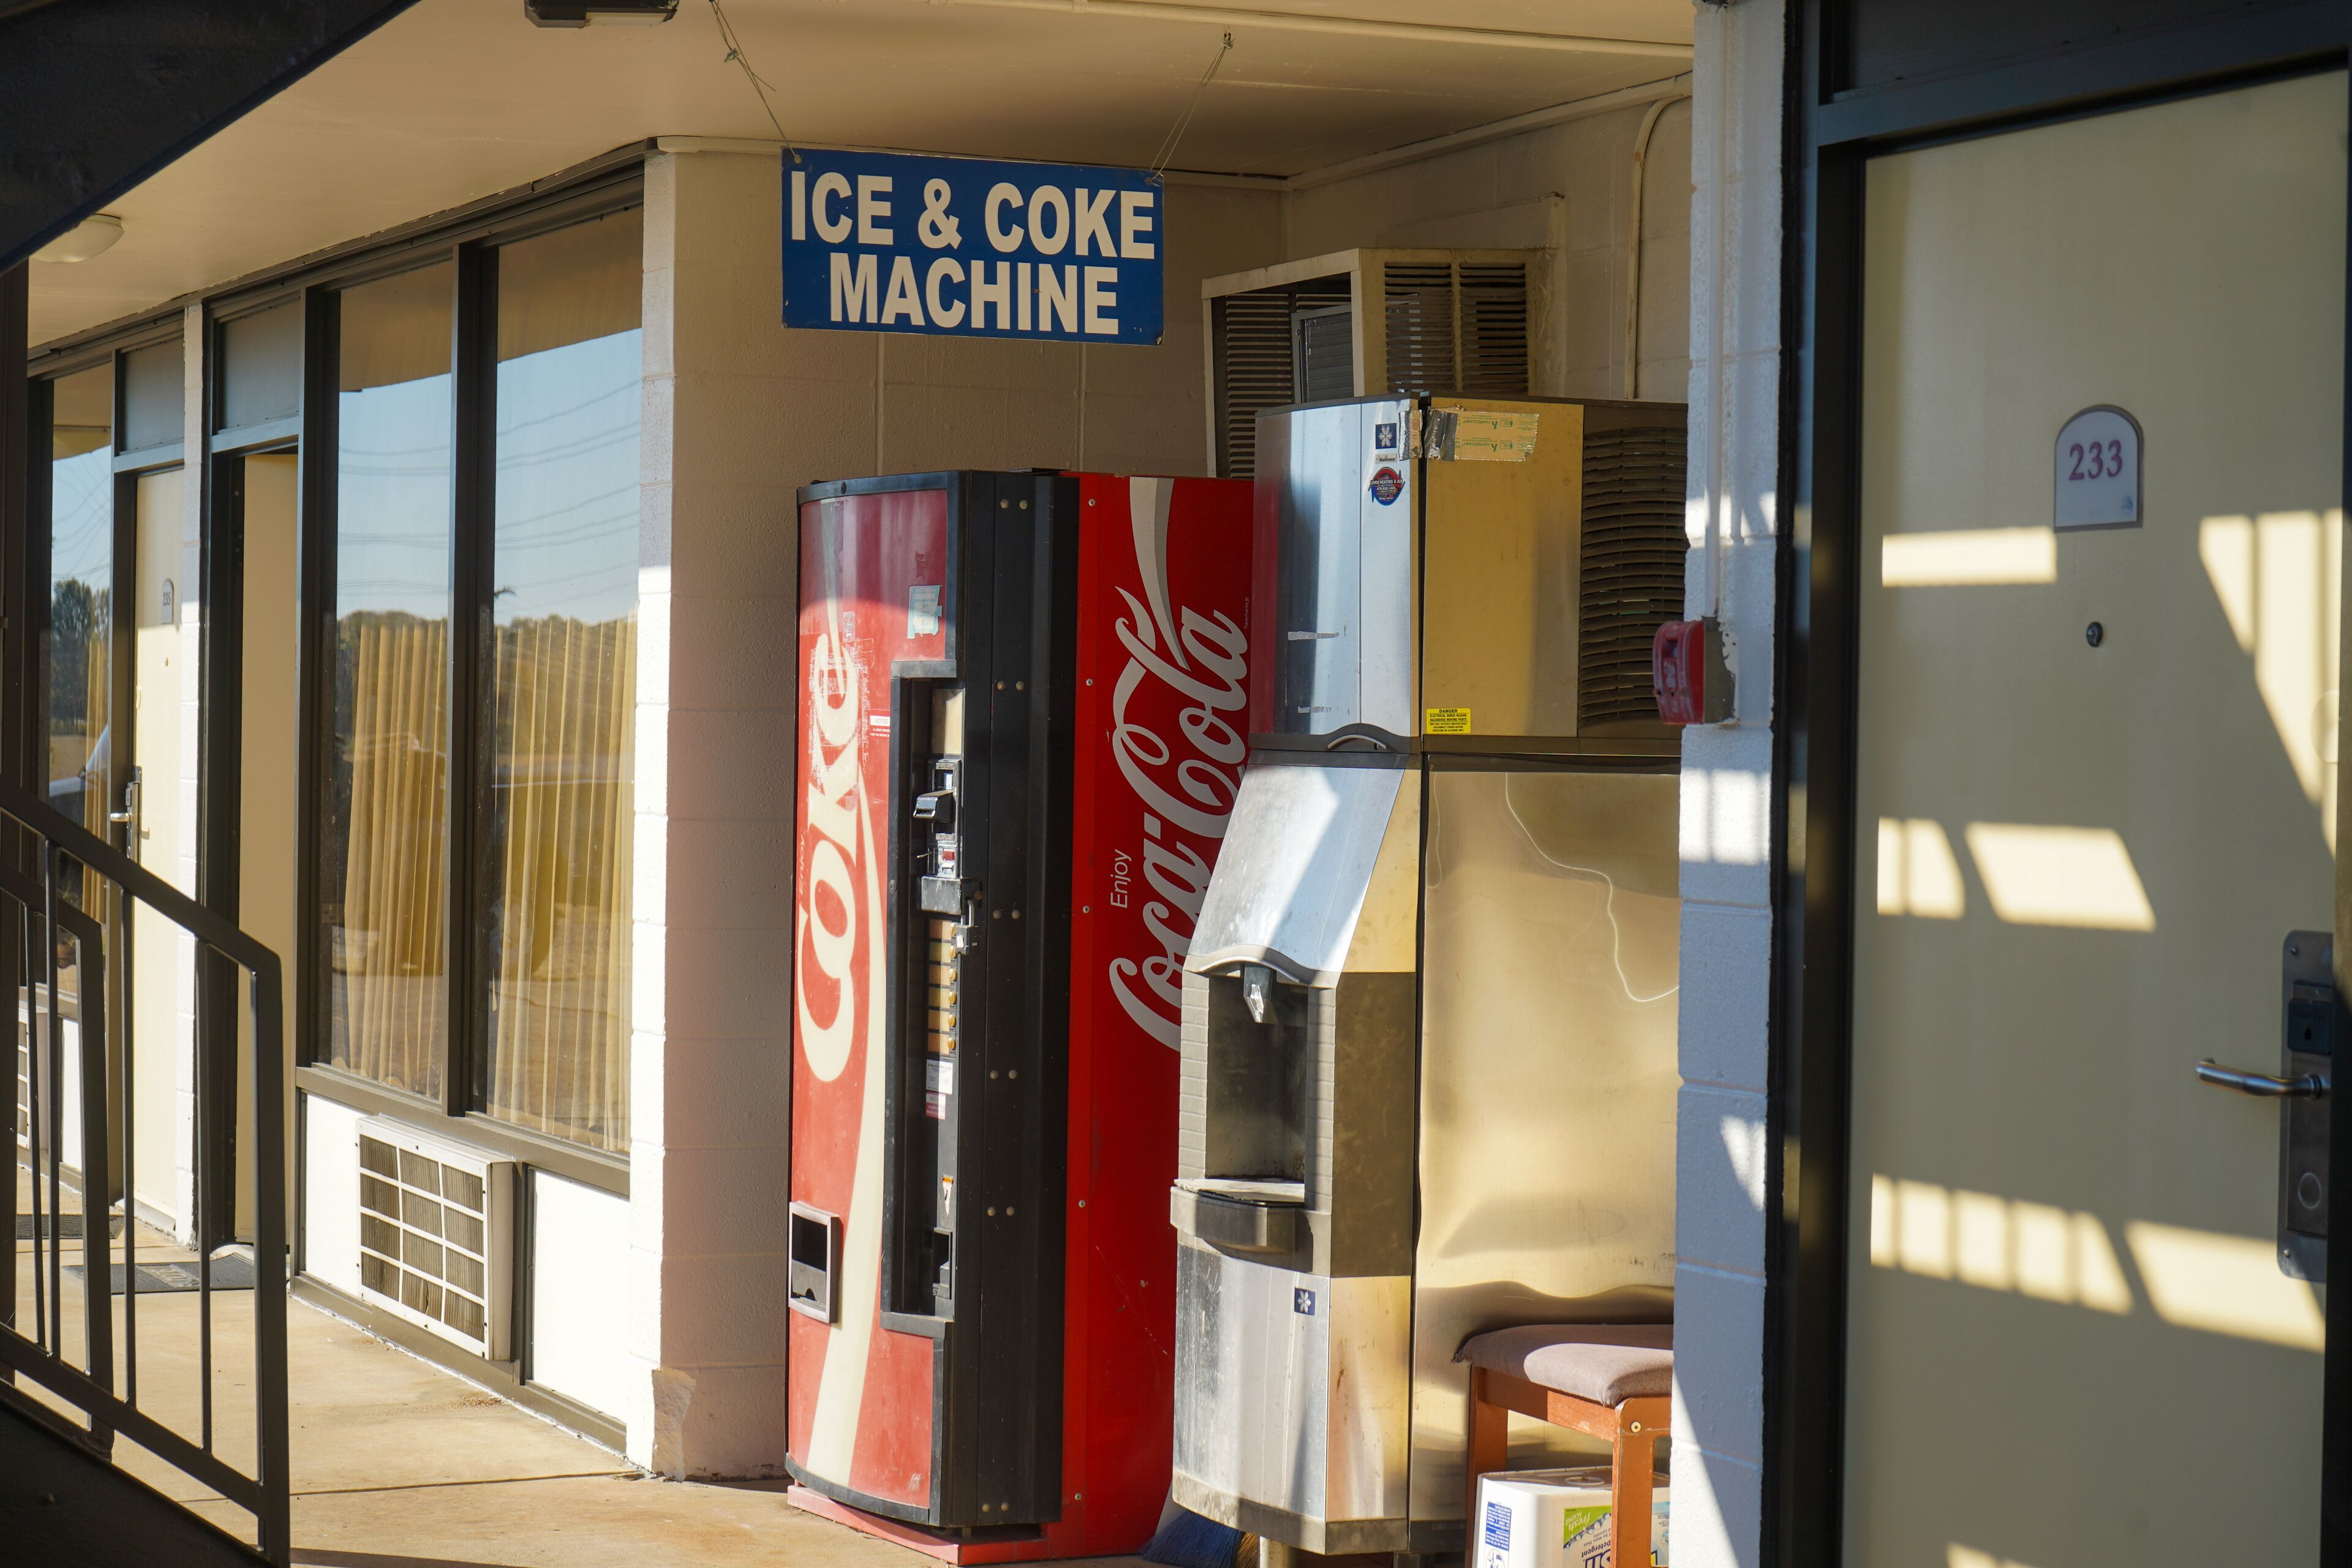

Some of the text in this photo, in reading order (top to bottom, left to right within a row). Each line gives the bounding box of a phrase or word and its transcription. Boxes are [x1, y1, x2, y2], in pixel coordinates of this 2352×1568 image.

[791, 171, 1155, 260] ICE & COKE
[829, 252, 1119, 335] MACHINE
[2068, 439, 2123, 481] 233
[1109, 586, 1249, 1052] Coca-Cola
[1110, 848, 1132, 908] Enjoy
[1569, 1512, 1591, 1531] fresh
[1581, 1540, 1610, 1558] Detergent
